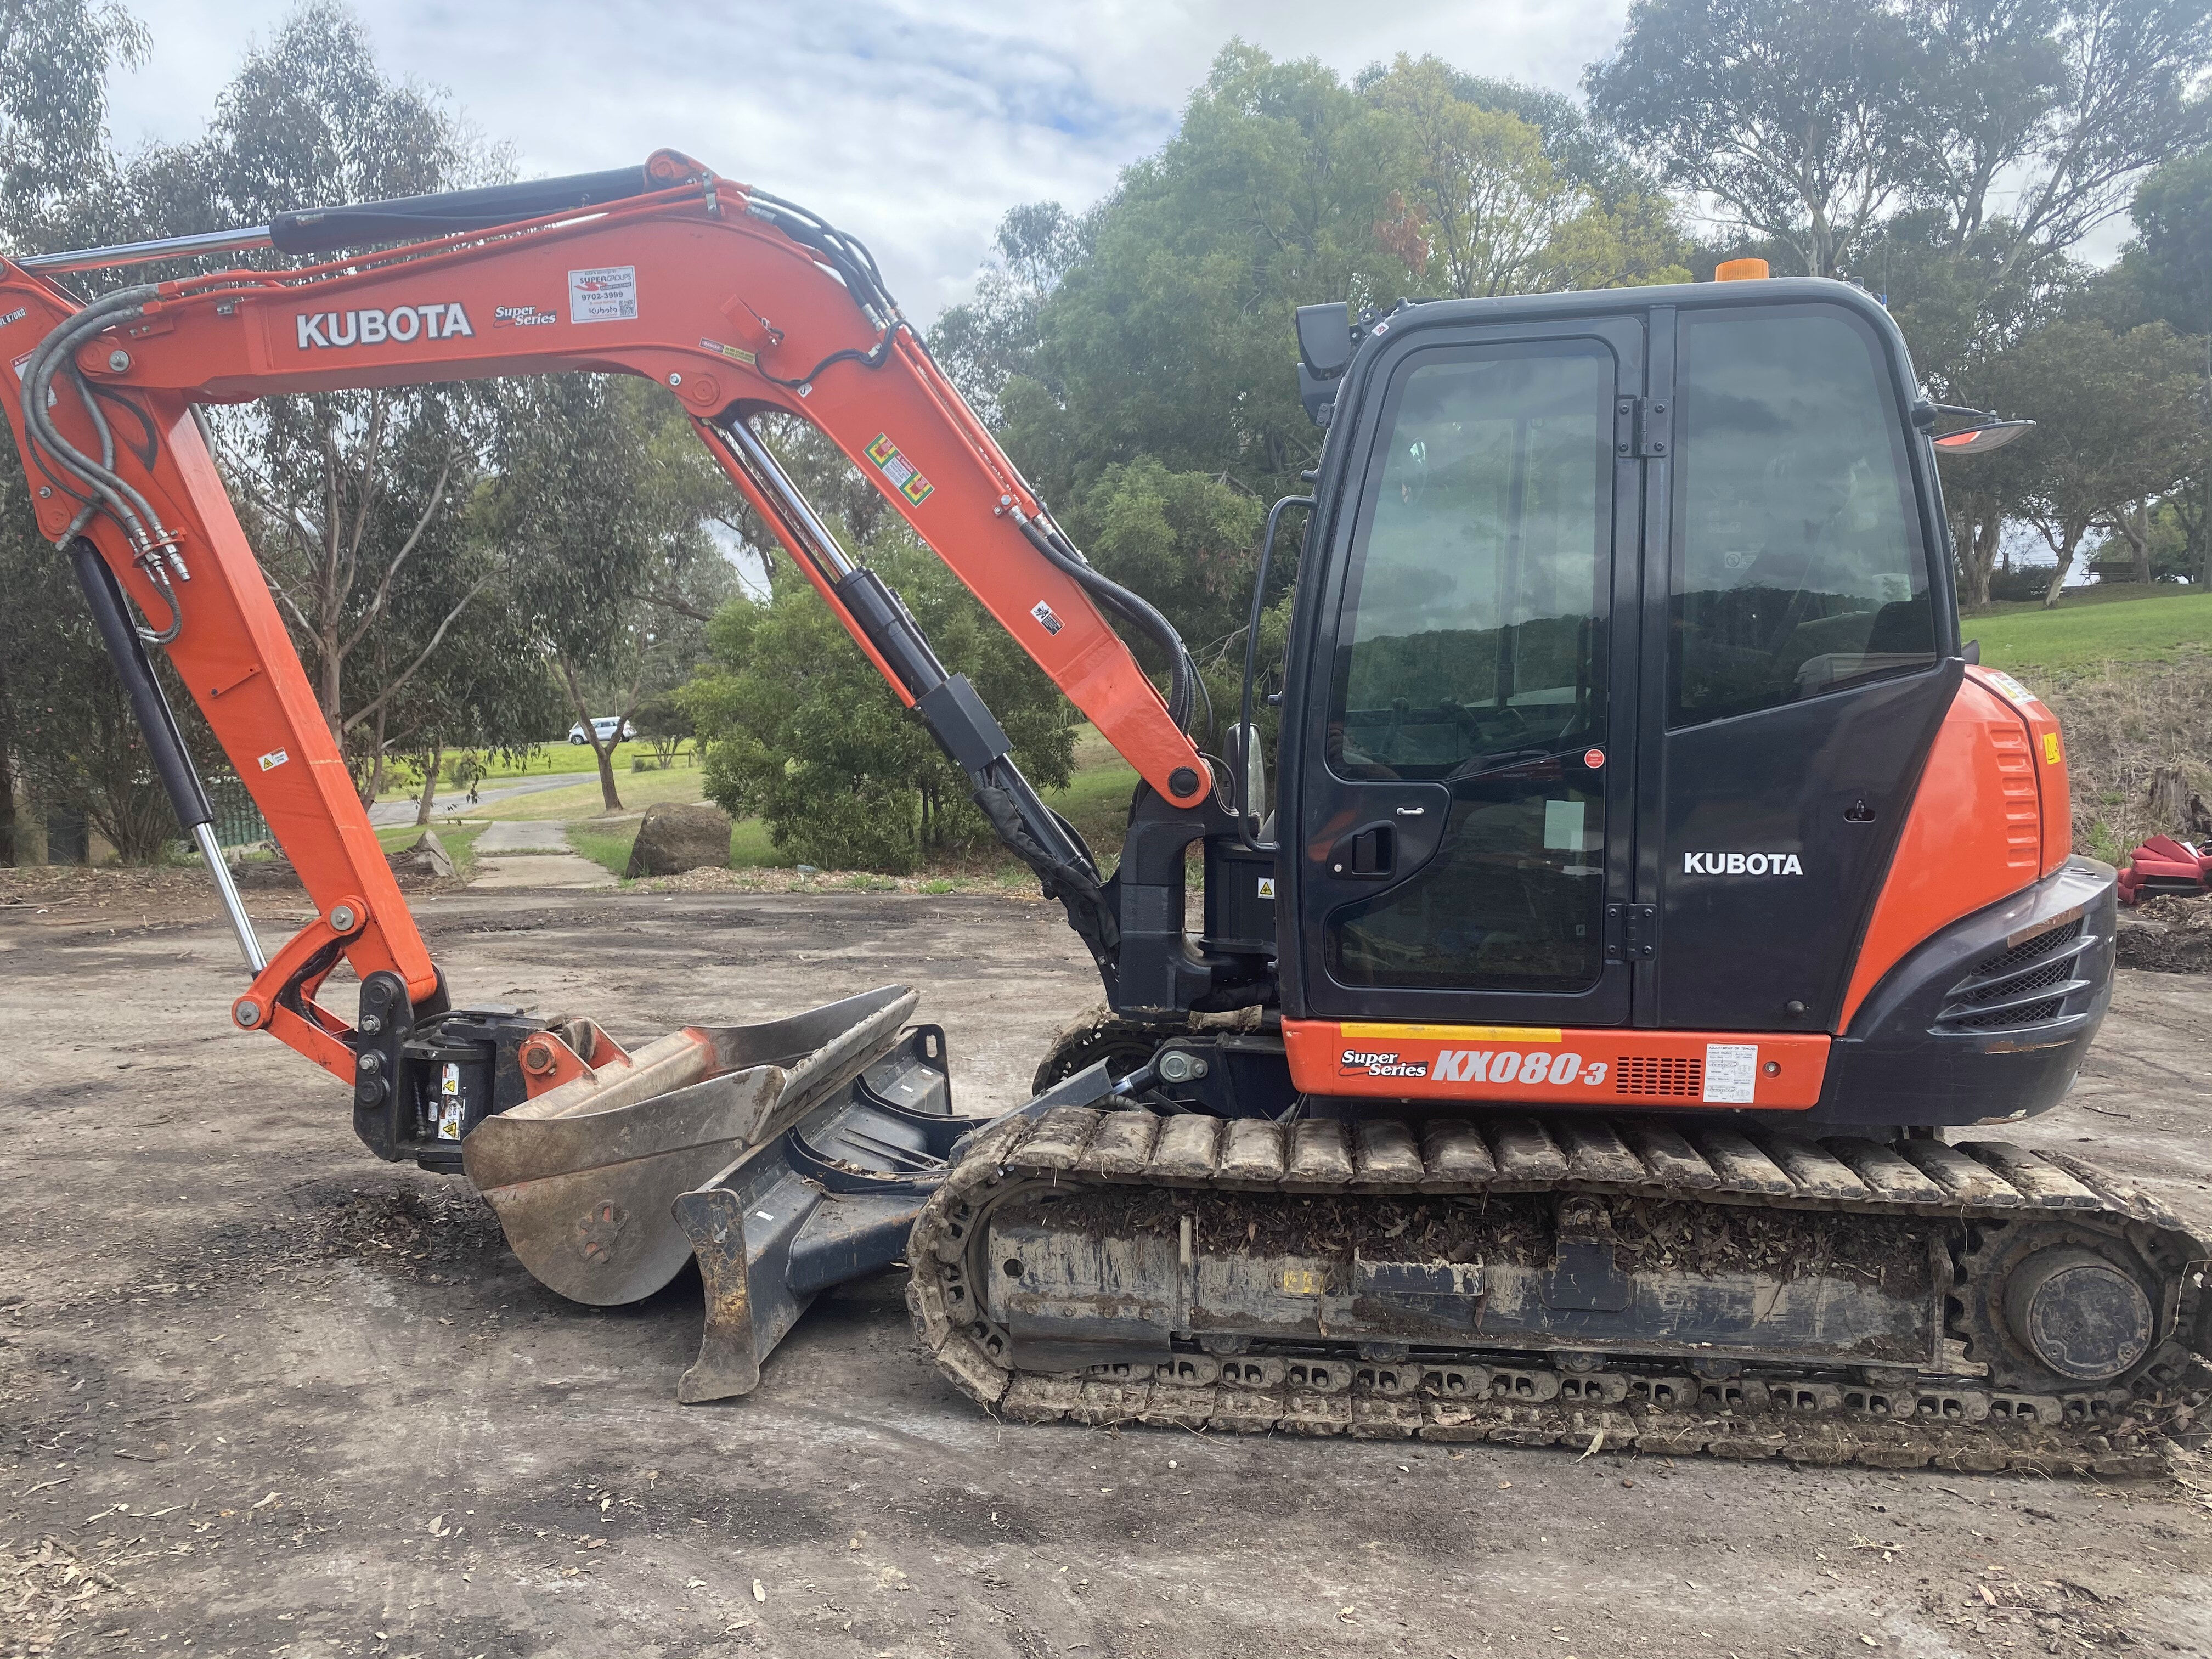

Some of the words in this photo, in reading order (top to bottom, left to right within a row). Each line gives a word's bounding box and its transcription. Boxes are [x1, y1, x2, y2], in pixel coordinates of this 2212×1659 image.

[580, 273, 631, 284] SUPERGROUPS
[582, 291, 623, 301] 9702-3999
[5, 308, 26, 323] 870KG
[495, 305, 536, 318] Super
[589, 306, 618, 314] Kubota
[296, 302, 473, 349] KUBOTA
[515, 314, 556, 326] Series
[1684, 852, 1804, 876] KUBOTA
[1341, 1050, 1398, 1066] Super
[1368, 1063, 1427, 1077] Series
[1431, 1049, 1609, 1086] KX080-3
